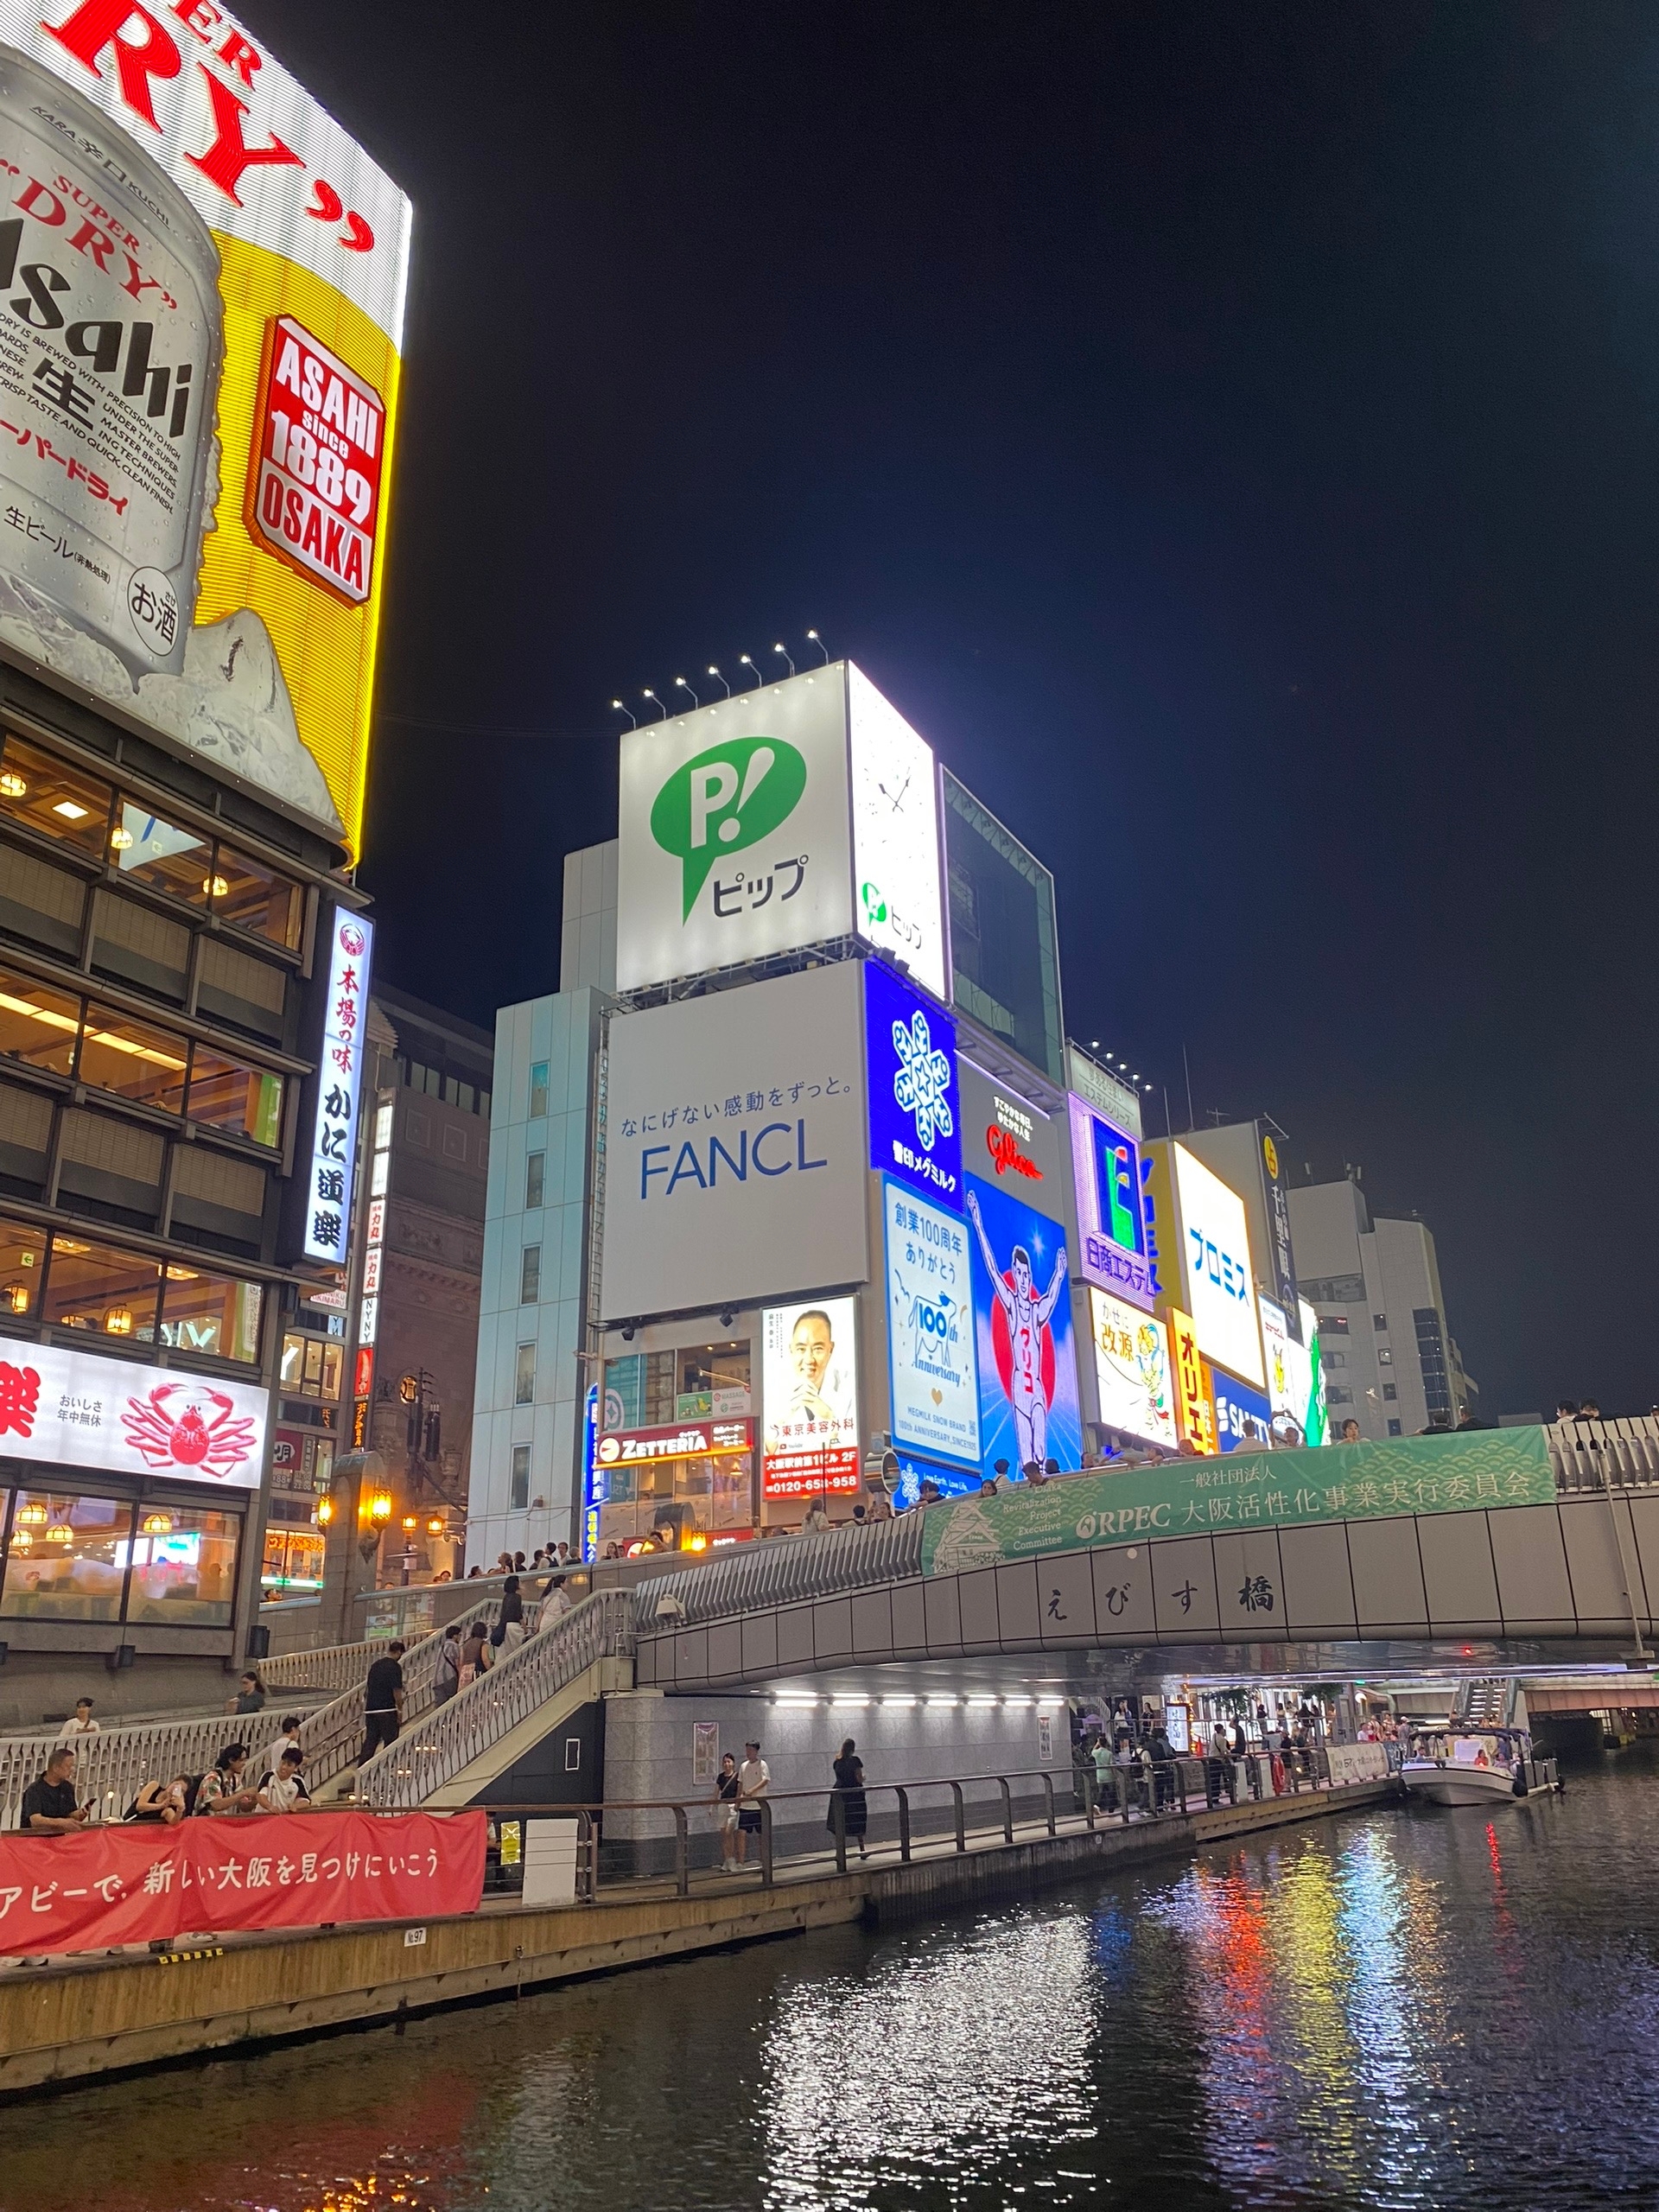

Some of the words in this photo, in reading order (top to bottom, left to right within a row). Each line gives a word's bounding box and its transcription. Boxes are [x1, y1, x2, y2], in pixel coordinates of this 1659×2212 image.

[30, 105, 76, 142] KARA
[53, 175, 140, 255] SUPER
[127, 181, 170, 230] KUCHI
[20, 327, 32, 339] IS
[32, 335, 77, 370] BREWED
[79, 367, 105, 393] WITH
[106, 391, 153, 433] PRECISION
[154, 429, 164, 444] TO
[163, 441, 181, 461] HIGH
[32, 357, 95, 430] 生
[276, 337, 378, 458] ASAHI
[0, 360, 24, 380] REW-
[98, 430, 119, 450] ING
[120, 446, 175, 500] TECHNIQUES
[27, 393, 61, 423] TASTE
[60, 419, 86, 440] AND
[122, 464, 150, 492] CLEAN
[100, 417, 142, 454] MASTER
[103, 402, 137, 435] UNDER
[138, 430, 158, 450] THE
[302, 409, 348, 460] since
[270, 410, 372, 524] 1889
[262, 472, 364, 591] OSAKA
[131, 582, 177, 645] お酒
[714, 855, 809, 918] ピップ
[332, 963, 359, 1076] 本場の味
[621, 1077, 850, 1137] なにげない感動をずっと。
[640, 1118, 828, 1200] FANCL
[893, 1140, 957, 1193] 雪印メグミルク
[987, 1124, 1043, 1179] Glico
[894, 1202, 963, 1256] 創業100周年
[906, 1241, 956, 1284] ありがとう
[1190, 1226, 1249, 1306] プロミス
[364, 1300, 372, 1343] NYNY
[918, 1303, 947, 1338] 100
[1101, 1323, 1135, 1362] 改源
[912, 1354, 961, 1389] Anniversary
[1020, 1327, 1034, 1394] グリコ
[57, 1408, 102, 1427] 年中無休
[60, 1394, 103, 1413] おいしさ
[782, 1417, 854, 1437] 東京美容外科
[907, 1406, 931, 1421] MEGMILK
[933, 1414, 948, 1427] SNOW
[949, 1420, 966, 1433] BRAND
[621, 1435, 708, 1459] ZETTERIA
[841, 1451, 856, 1463] 2F
[1179, 1465, 1277, 1489] 一般社団法人
[1181, 1471, 1530, 1527] 大阪活性化事業実行委員会
[1003, 1496, 1062, 1513] Revitalization
[1018, 1522, 1061, 1535] Executive
[1030, 1508, 1061, 1521] Project
[1075, 1503, 1172, 1540] ORPEC
[1013, 1536, 1063, 1551] Committee
[1047, 1575, 1274, 1621] えびす橋
